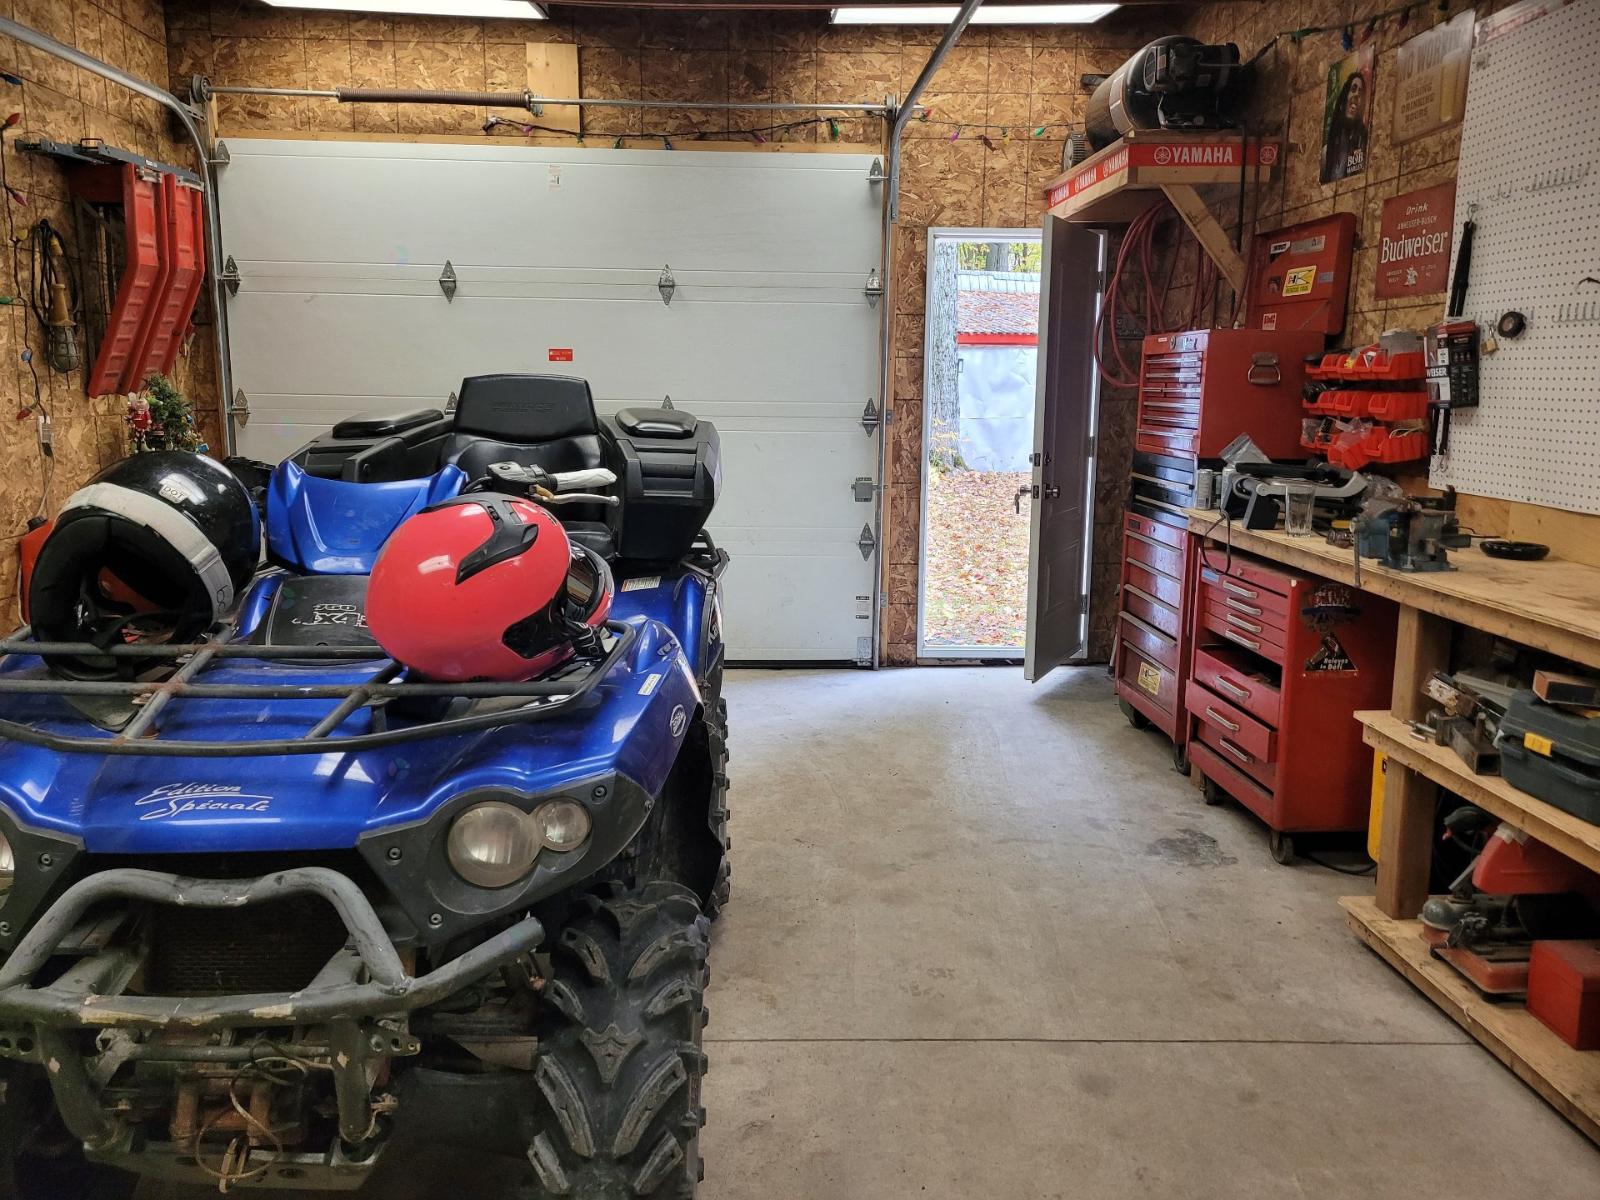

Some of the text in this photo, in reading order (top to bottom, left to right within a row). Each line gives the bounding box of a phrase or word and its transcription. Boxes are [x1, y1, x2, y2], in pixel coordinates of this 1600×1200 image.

[1401, 93, 1434, 113] DRINKING
[1172, 147, 1233, 163] YAMAHA
[1348, 152, 1364, 167] BOB
[1406, 202, 1428, 215] Drink
[1381, 229, 1448, 263] Budweiser
[163, 486, 185, 499] DOT
